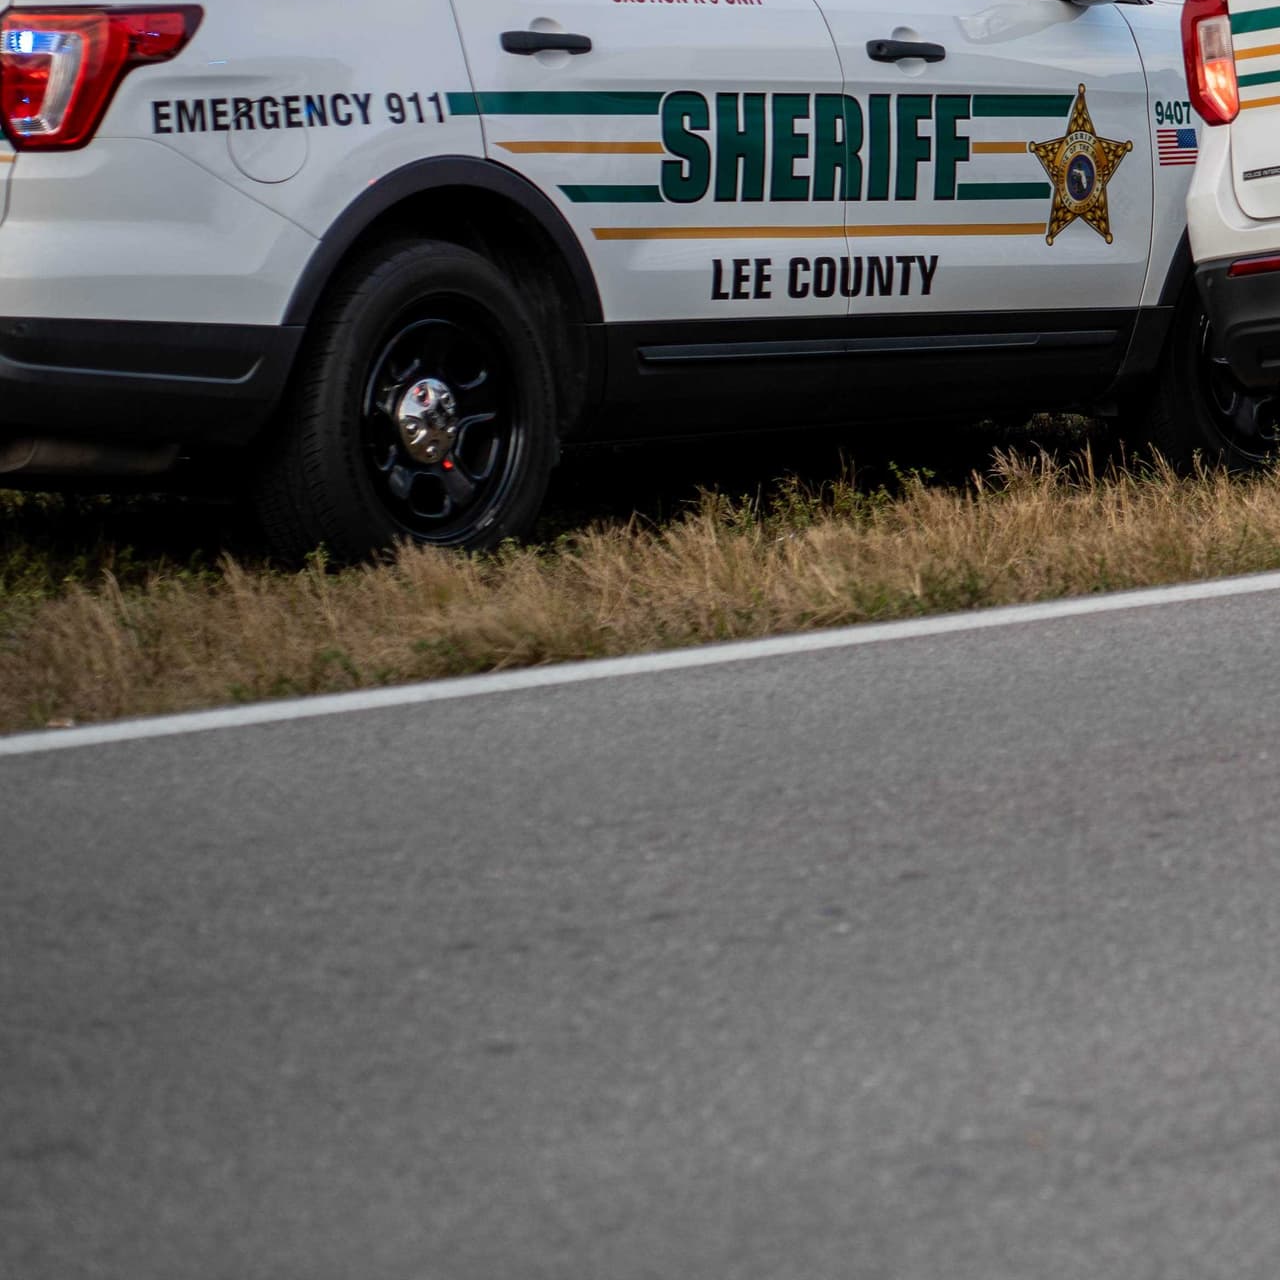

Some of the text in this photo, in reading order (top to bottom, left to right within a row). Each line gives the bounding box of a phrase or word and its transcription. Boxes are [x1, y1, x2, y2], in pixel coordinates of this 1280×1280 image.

[152, 91, 446, 134] EMERGENCY 911
[1155, 100, 1191, 125] 9407
[660, 90, 972, 204] SHERIFF
[711, 255, 939, 301] LEE COUNTY
